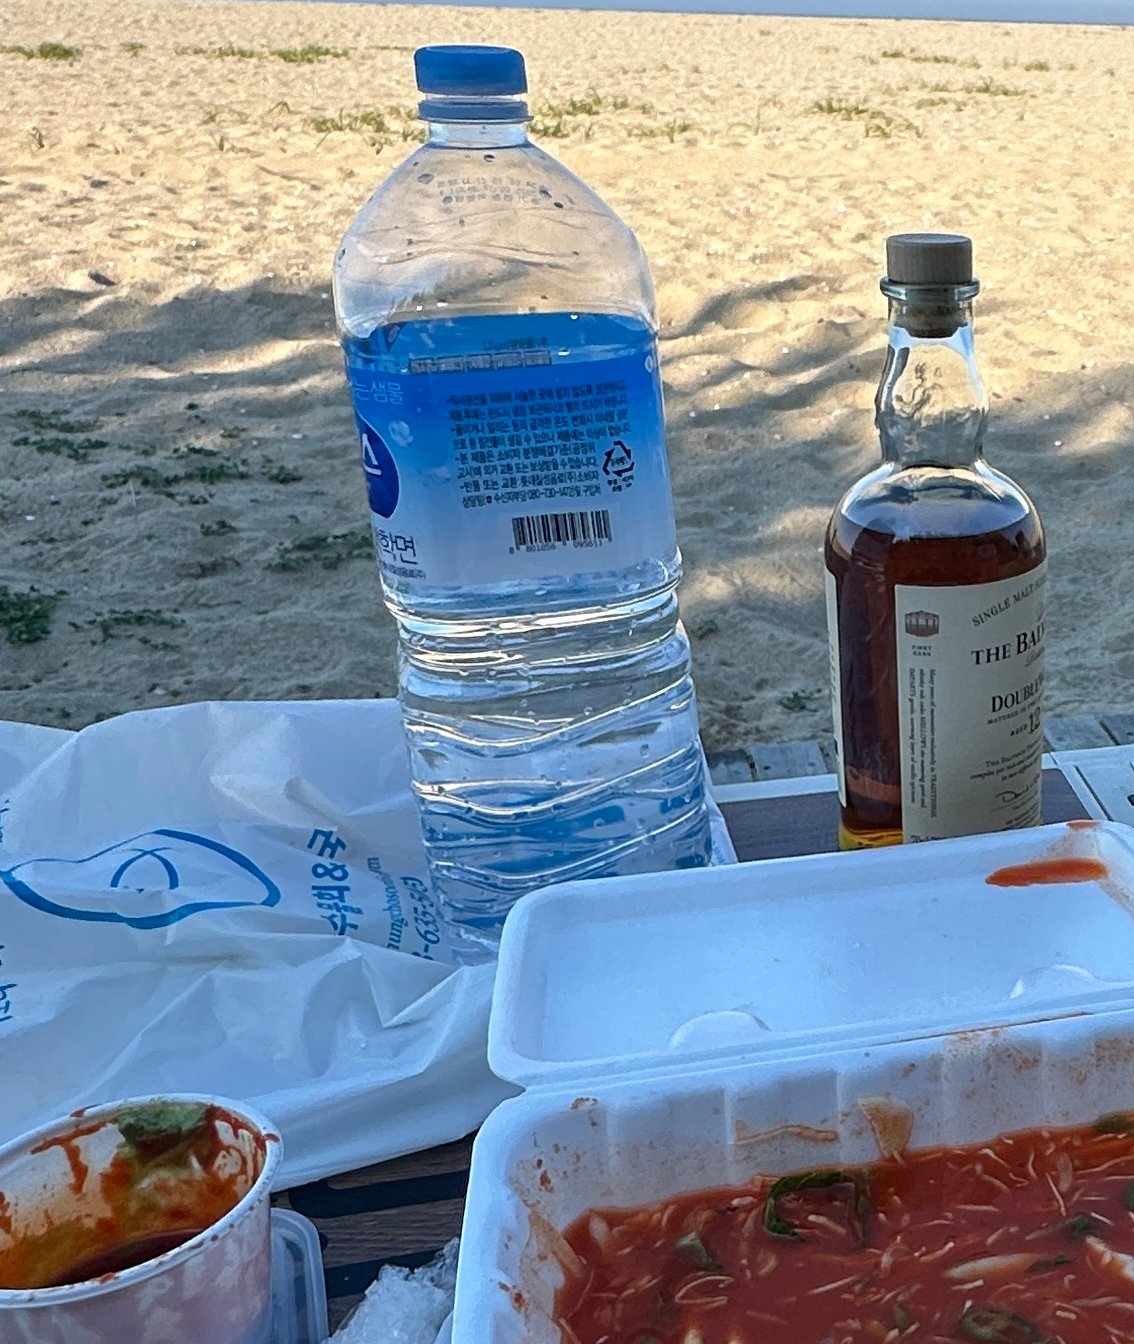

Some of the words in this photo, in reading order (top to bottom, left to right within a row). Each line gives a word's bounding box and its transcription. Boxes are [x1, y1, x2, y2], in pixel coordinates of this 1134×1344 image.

[972, 597, 1011, 627] SINGLE
[1012, 583, 1035, 604] MALT
[971, 642, 1011, 665] THE
